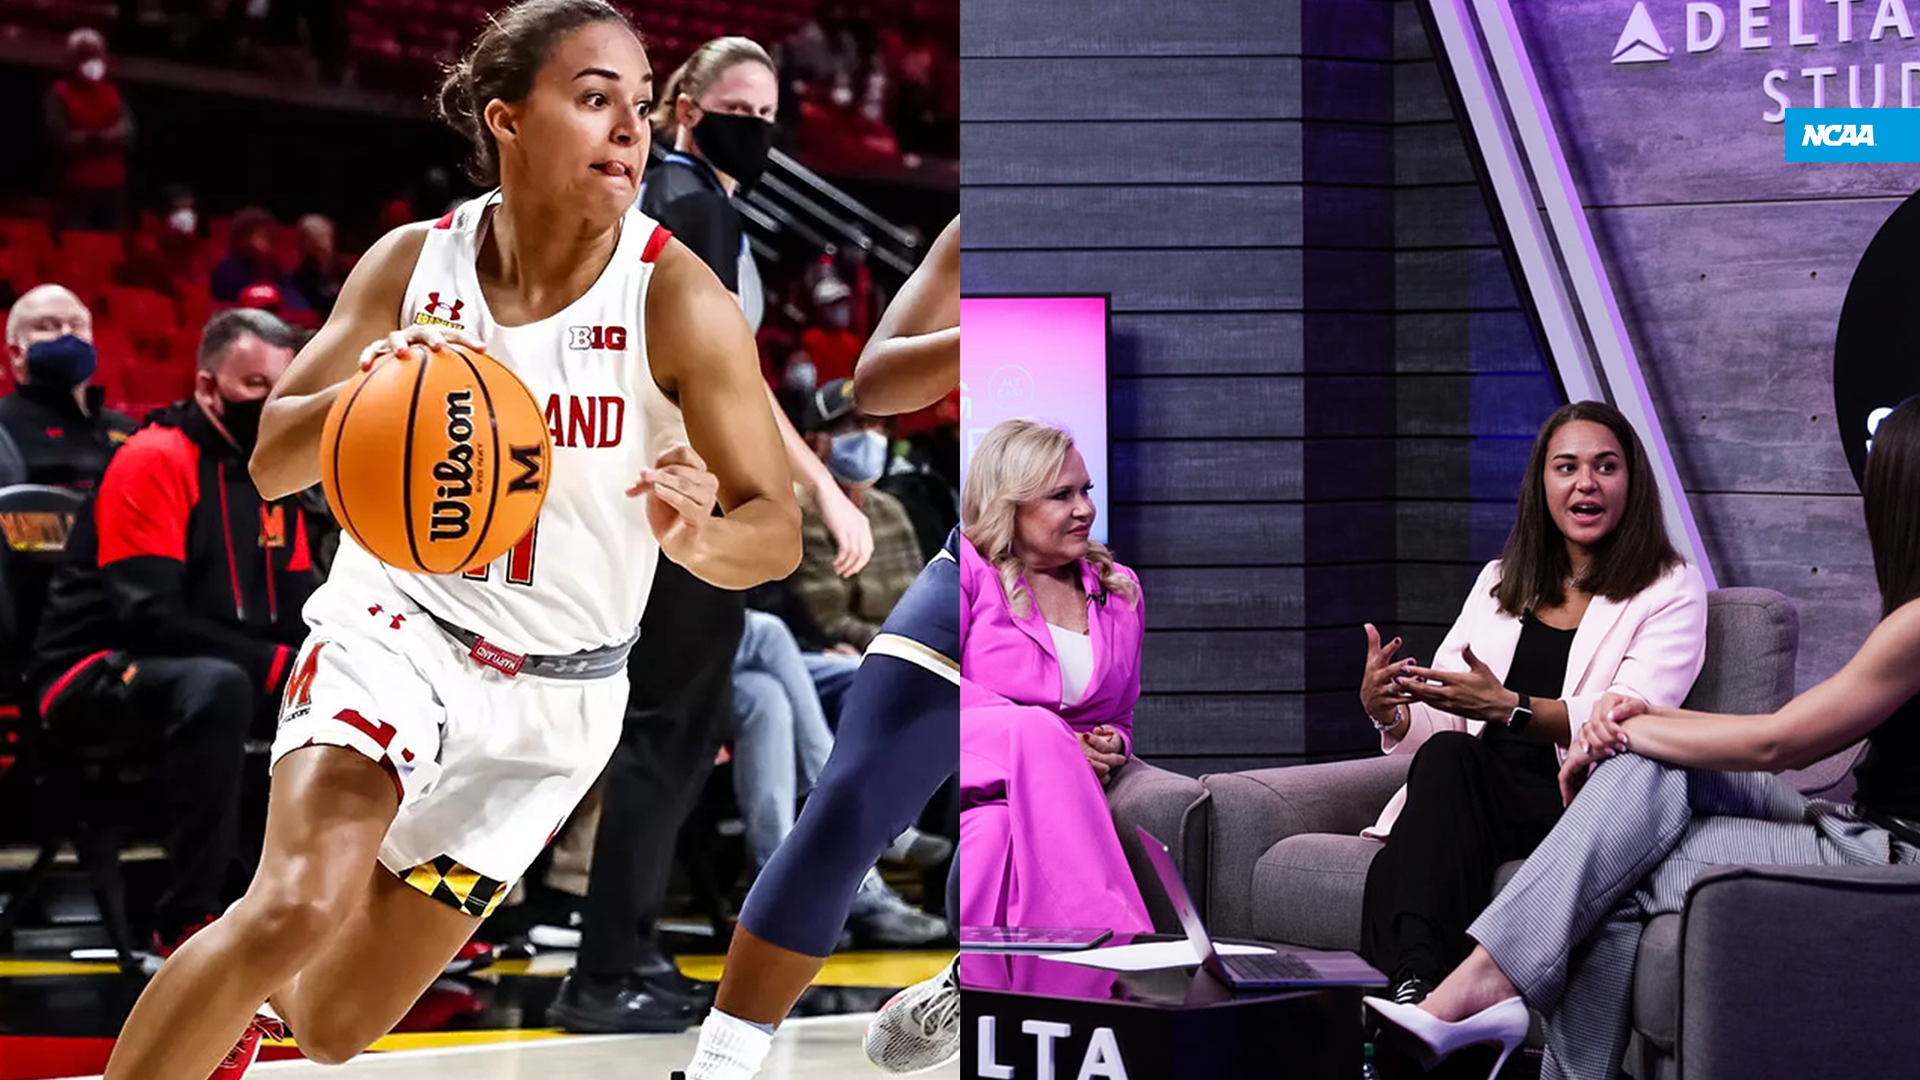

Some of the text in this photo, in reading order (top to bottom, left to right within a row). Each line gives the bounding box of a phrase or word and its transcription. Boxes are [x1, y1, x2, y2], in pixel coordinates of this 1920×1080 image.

[1686, 0, 1915, 53] DELTA
[430, 390, 473, 542] Wilson
[507, 442, 544, 496] M
[978, 1015, 1129, 1080] LTA
